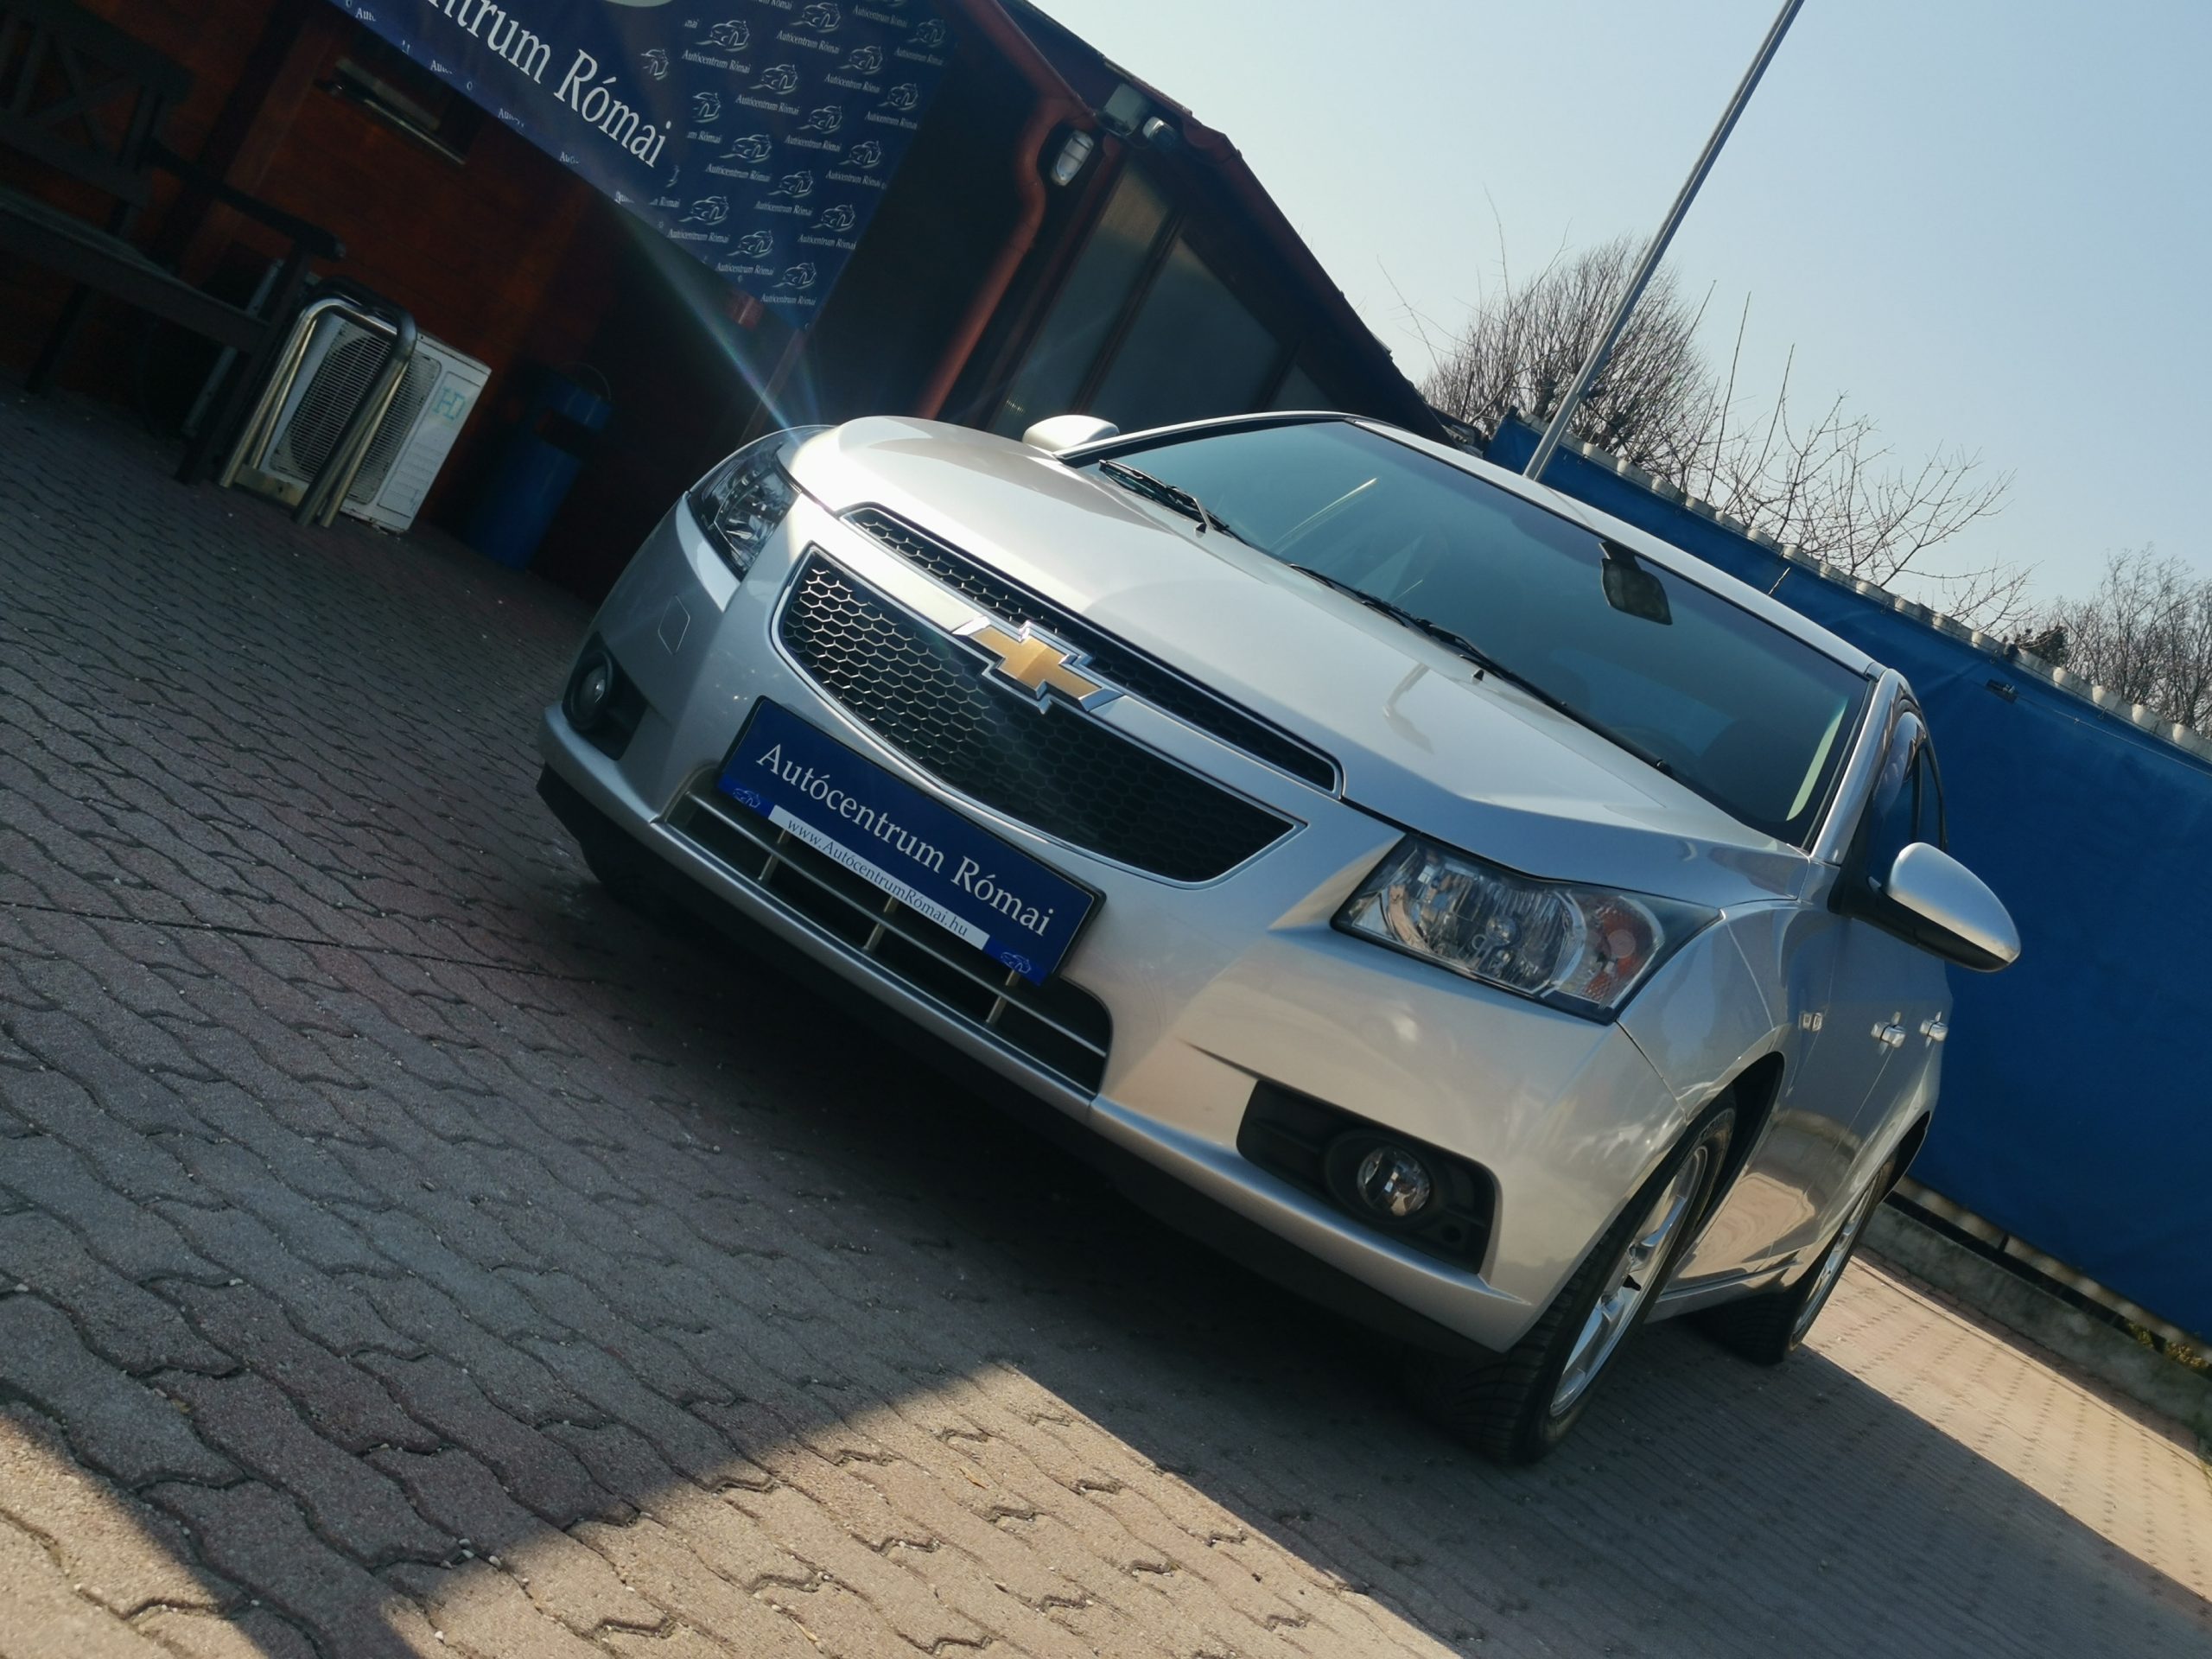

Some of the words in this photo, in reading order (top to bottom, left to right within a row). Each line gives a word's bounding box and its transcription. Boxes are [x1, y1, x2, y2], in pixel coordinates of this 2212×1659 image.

[554, 48, 671, 168] Római
[757, 743, 944, 874] Autócentrum
[950, 855, 1054, 936] Római
[788, 820, 968, 937] www.AutócentrumRómai.hu
